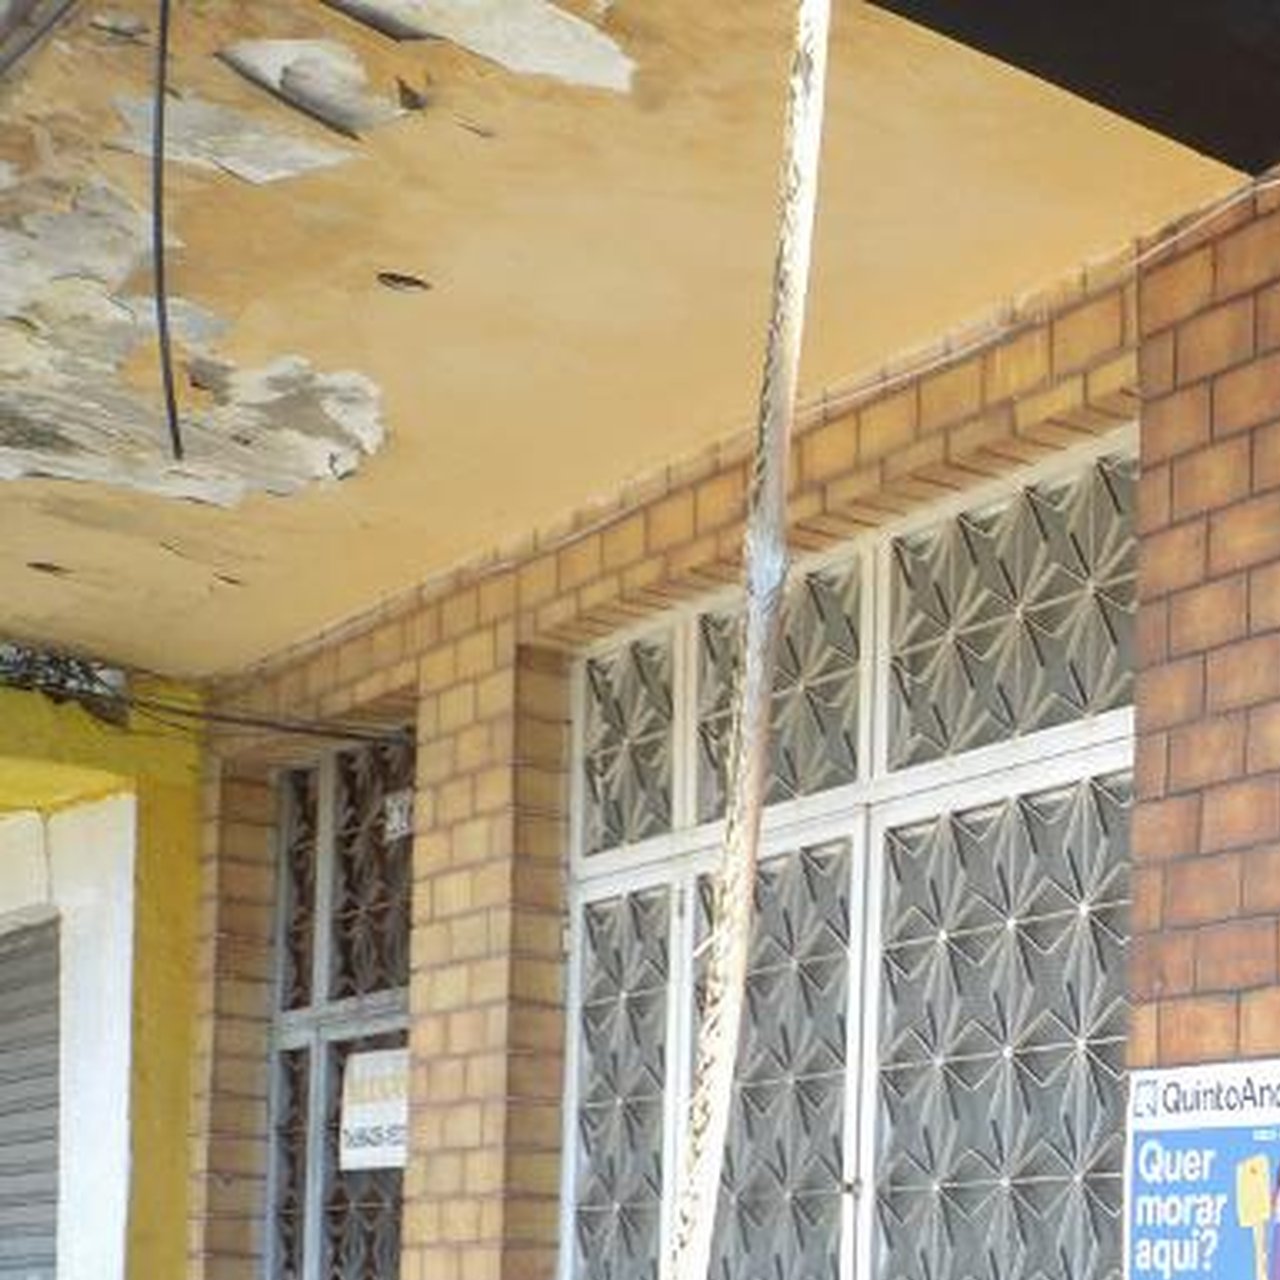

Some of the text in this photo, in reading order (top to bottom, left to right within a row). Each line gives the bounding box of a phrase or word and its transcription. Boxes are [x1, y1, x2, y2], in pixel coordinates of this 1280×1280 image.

[1139, 1140, 1217, 1184] Quer
[1136, 1193, 1229, 1229] morar
[1135, 1228, 1219, 1280] aqui?
